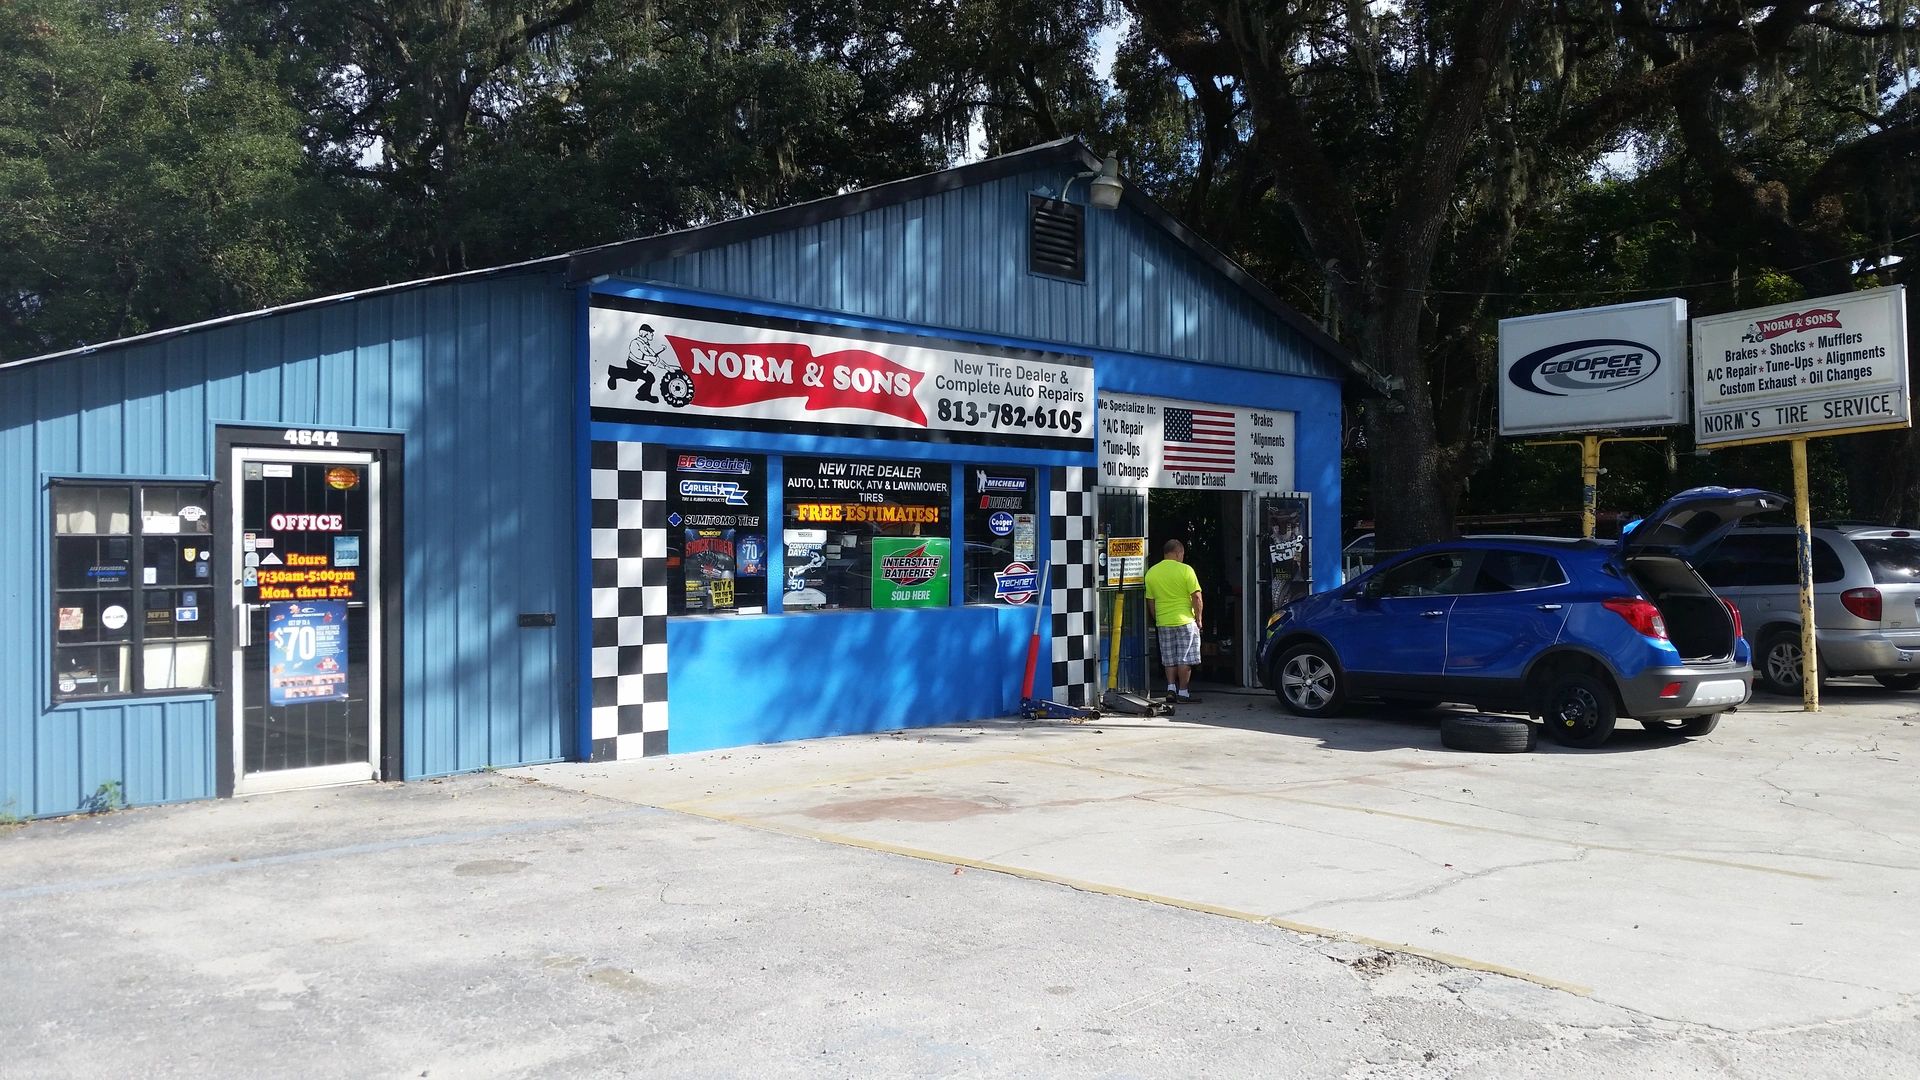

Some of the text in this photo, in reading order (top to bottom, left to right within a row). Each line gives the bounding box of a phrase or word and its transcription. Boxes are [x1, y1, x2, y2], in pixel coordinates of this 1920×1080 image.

[1762, 313, 1834, 333] NORM & SONS
[1725, 332, 1863, 362] Brakes Shocks Mufflers
[954, 359, 1069, 385] New Tire Dealer &
[1540, 353, 1643, 375] COOPER
[1707, 347, 1886, 382] A/C Repair Tune-Ups Alignments
[691, 348, 911, 397] NORM & SONS
[1589, 366, 1641, 380] TIRES
[935, 375, 1084, 403] Complete Auto Repairs
[1719, 366, 1872, 396] Custom Exhaust Oil Changes
[1097, 398, 1156, 415] We Specialize In:
[1704, 394, 1891, 433] NORM'S TIRE SERVICE
[937, 398, 1083, 434] 813-782-6105
[1120, 420, 1144, 438] Repair
[283, 429, 339, 446] 4644
[677, 455, 751, 471] BFGoodrich
[818, 462, 922, 478] NEW TIRE DEALER
[1118, 461, 1149, 480] Changes
[787, 477, 948, 492] AUTO, LT. TRUCK, ATV & LAWNMOWER
[987, 480, 1025, 488] MICHELIN
[1201, 472, 1226, 487] Exhaust
[683, 484, 717, 492] CARLISLE
[858, 492, 884, 503] TIRES
[684, 514, 759, 526] SUMITOMO TIRE
[797, 504, 939, 523] FREE ESTIMATES!
[270, 514, 343, 531] OFFICE
[991, 518, 1013, 526] Cooper
[742, 544, 757, 560] $70
[787, 549, 810, 557] DAYS!
[1112, 542, 1140, 552] CUSTOMERS
[286, 553, 328, 566] Hours
[883, 557, 940, 567] INTERSTATE
[257, 570, 355, 583] 7:30am-5:00pm
[884, 568, 936, 578] BATTERIES
[260, 585, 353, 599] Mon. thru Fri.
[713, 581, 726, 591] BUY
[788, 579, 805, 591] $50
[891, 590, 931, 601] SOLD HERE
[273, 626, 316, 661] $70
